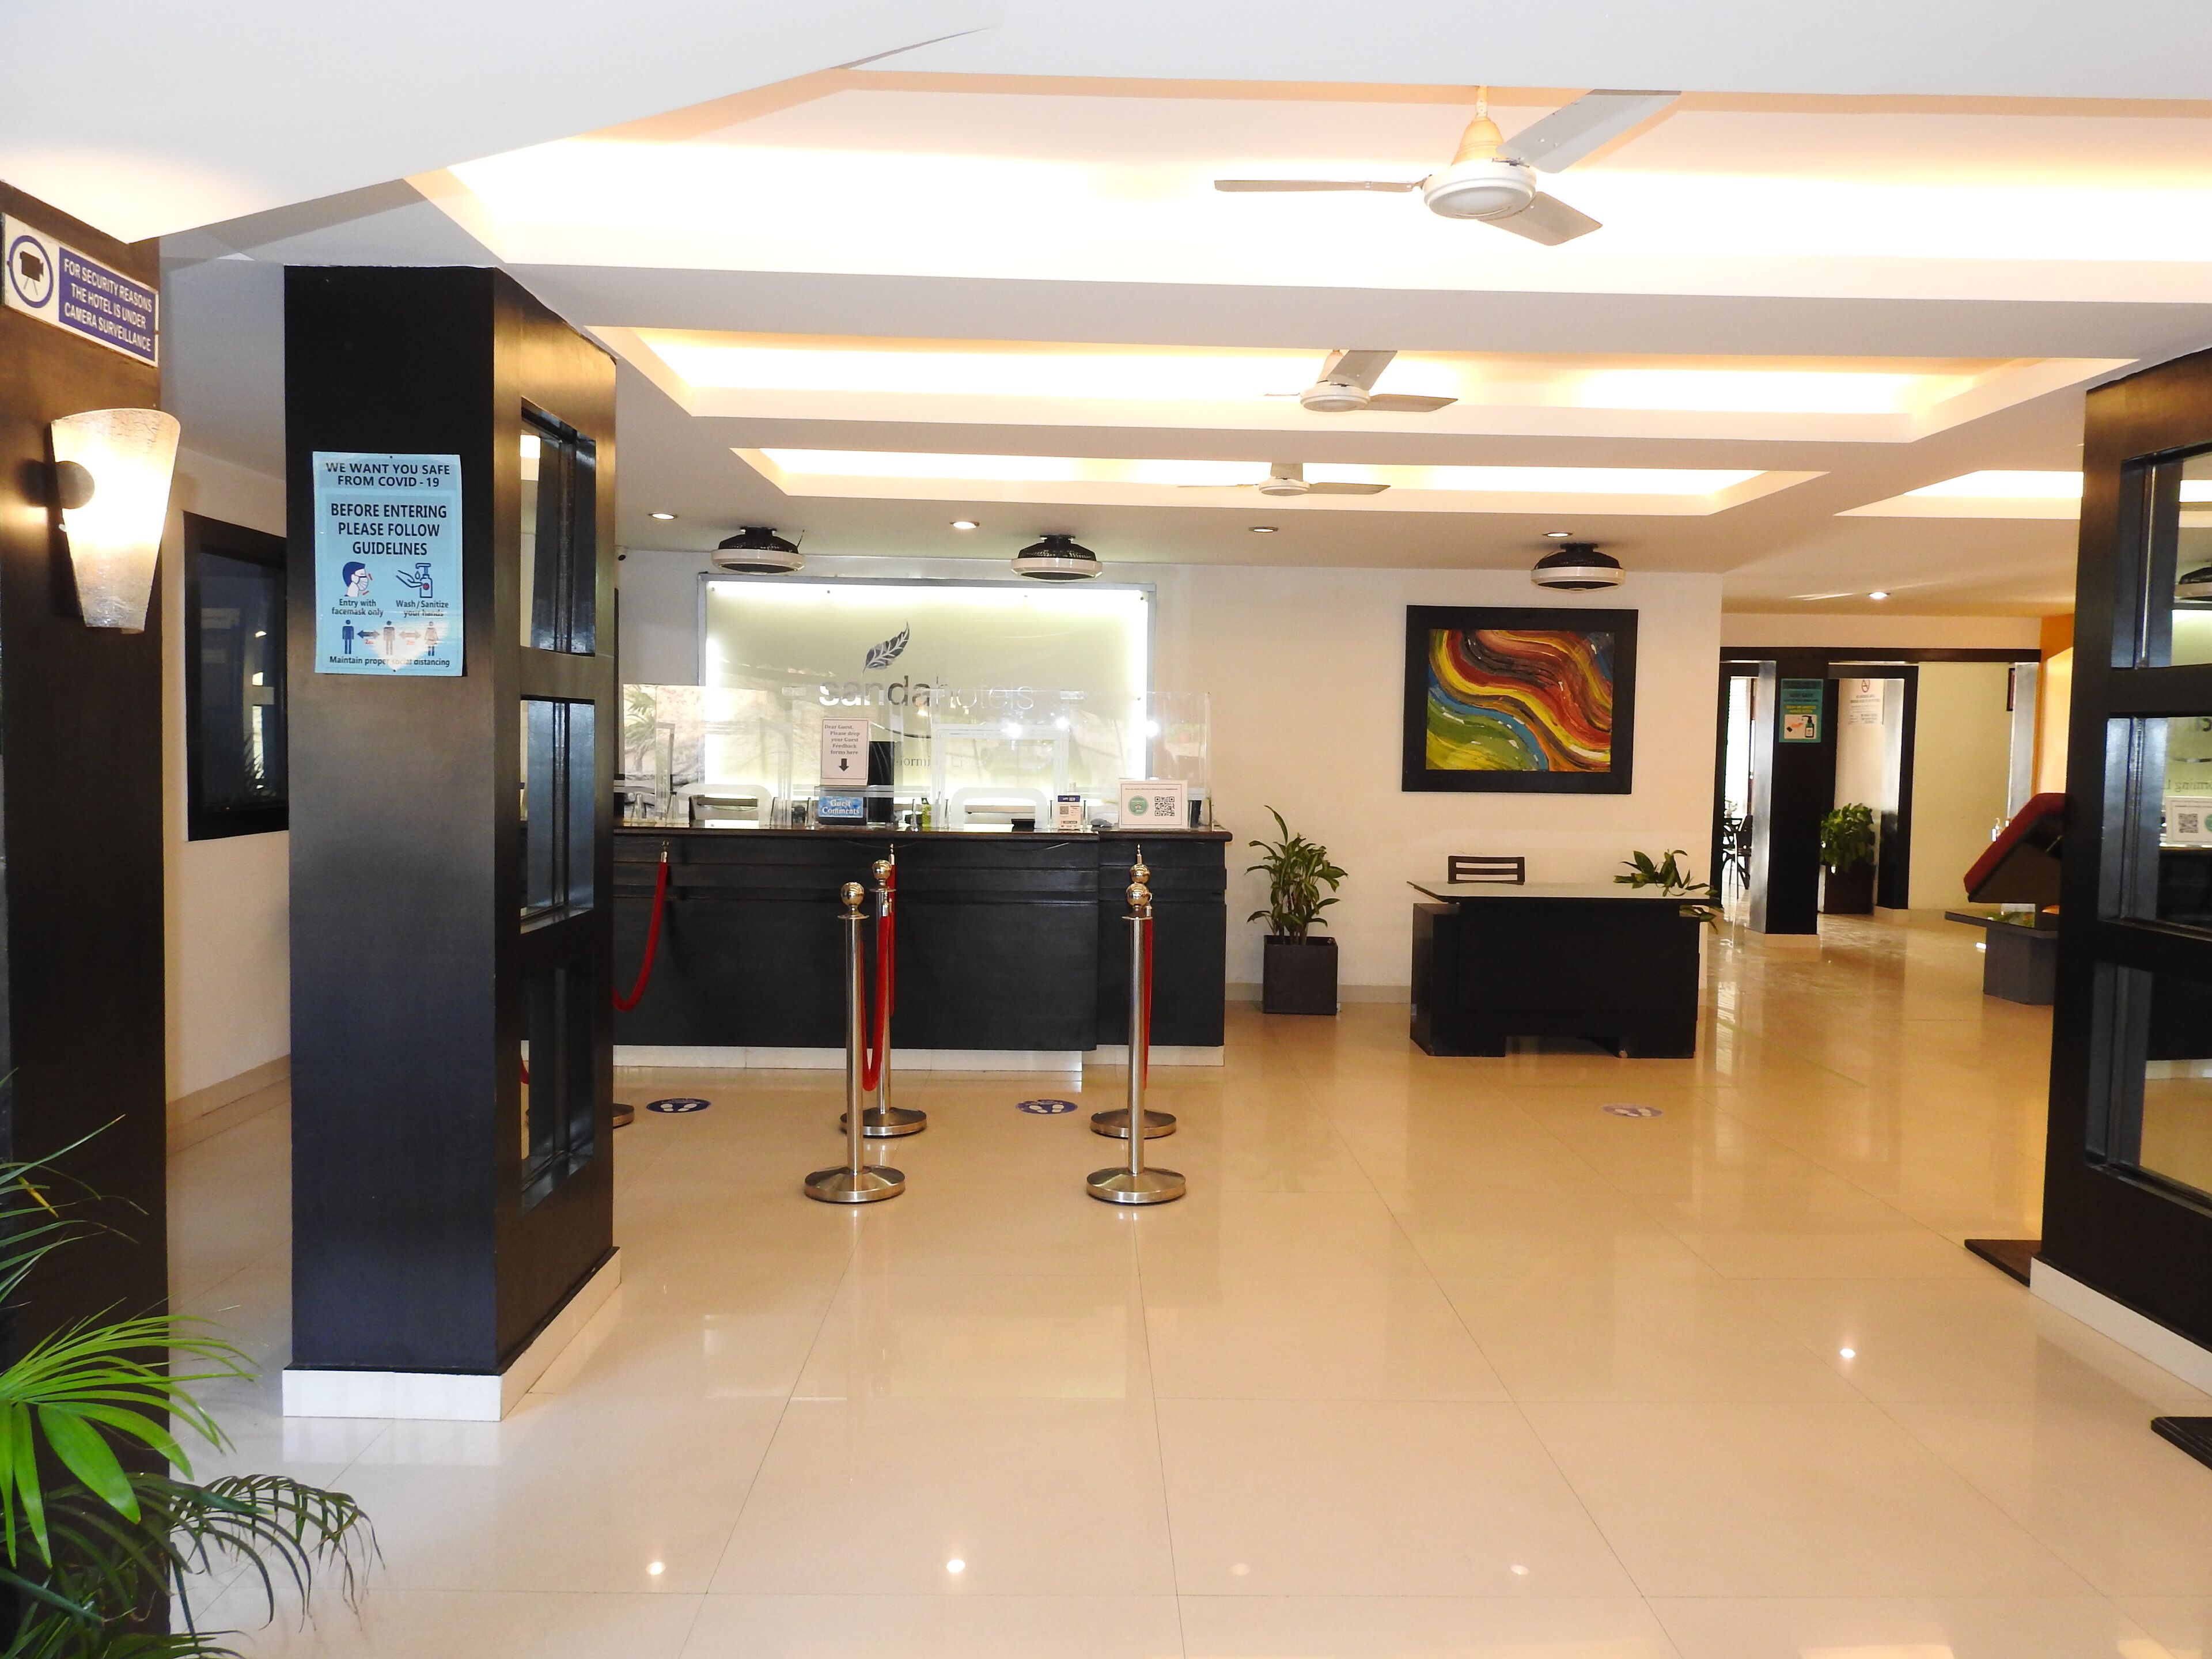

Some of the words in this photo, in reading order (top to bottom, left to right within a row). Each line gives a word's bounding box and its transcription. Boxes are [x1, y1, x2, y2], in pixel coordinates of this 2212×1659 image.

[64, 257, 81, 279] FOR
[82, 267, 119, 297] SECURITY
[119, 285, 153, 313] REASONS
[71, 283, 87, 303] THE
[88, 291, 113, 315] HOTEL
[113, 303, 121, 319] IS
[122, 308, 146, 330] UNDER
[64, 302, 98, 329] CAMERA
[98, 316, 151, 352] SURVEILLANCE
[326, 463, 346, 473] WE
[350, 463, 389, 474] WANT
[392, 464, 418, 475] YOU
[422, 465, 450, 475] SAFE
[338, 476, 374, 486] FROM
[378, 476, 416, 487] COVID
[426, 477, 440, 487] 19
[331, 503, 380, 517] BEFORE
[384, 505, 447, 518] ENTERING
[338, 522, 384, 536] PLEASE
[388, 523, 440, 537] FOLLOW
[353, 541, 427, 555] GUIDELINES
[339, 599, 358, 608] Entry
[368, 608, 384, 618] only
[329, 656, 363, 664] Maintain
[365, 658, 389, 666] proper
[414, 658, 450, 667] distancing
